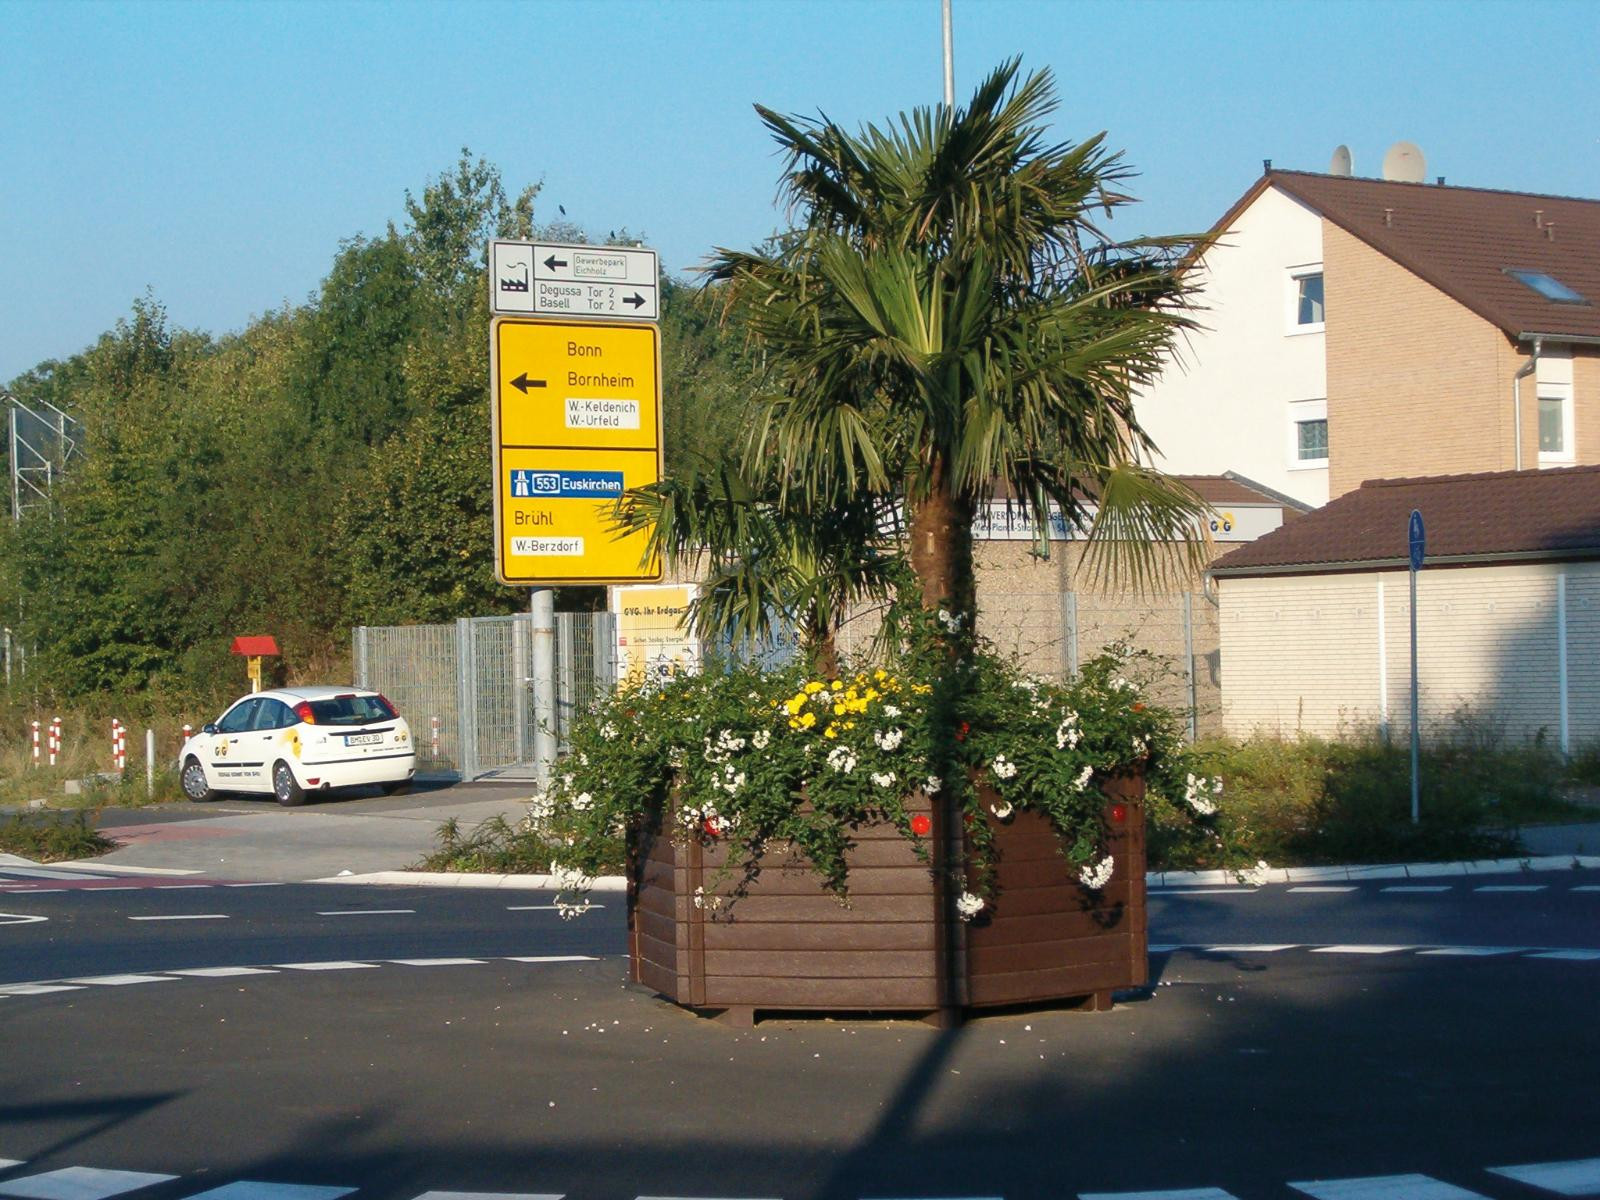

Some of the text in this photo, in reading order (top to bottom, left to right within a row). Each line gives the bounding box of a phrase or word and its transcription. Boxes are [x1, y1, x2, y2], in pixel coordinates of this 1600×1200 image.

[576, 256, 624, 267] Gewerbepark
[576, 266, 606, 275] Eichholz
[540, 284, 615, 298] Degussa Tor 2
[540, 297, 615, 310] Basell Tor 2
[568, 341, 602, 357] Bonn
[568, 372, 634, 387] Bornheim
[568, 400, 636, 413] W.-Keldenich
[569, 415, 619, 427] W.-Urfeld
[536, 478, 621, 491] 553 Euskirchen
[514, 510, 554, 525] Brühl
[516, 540, 580, 552] W.-Berzdorf
[644, 606, 655, 615] Ihr
